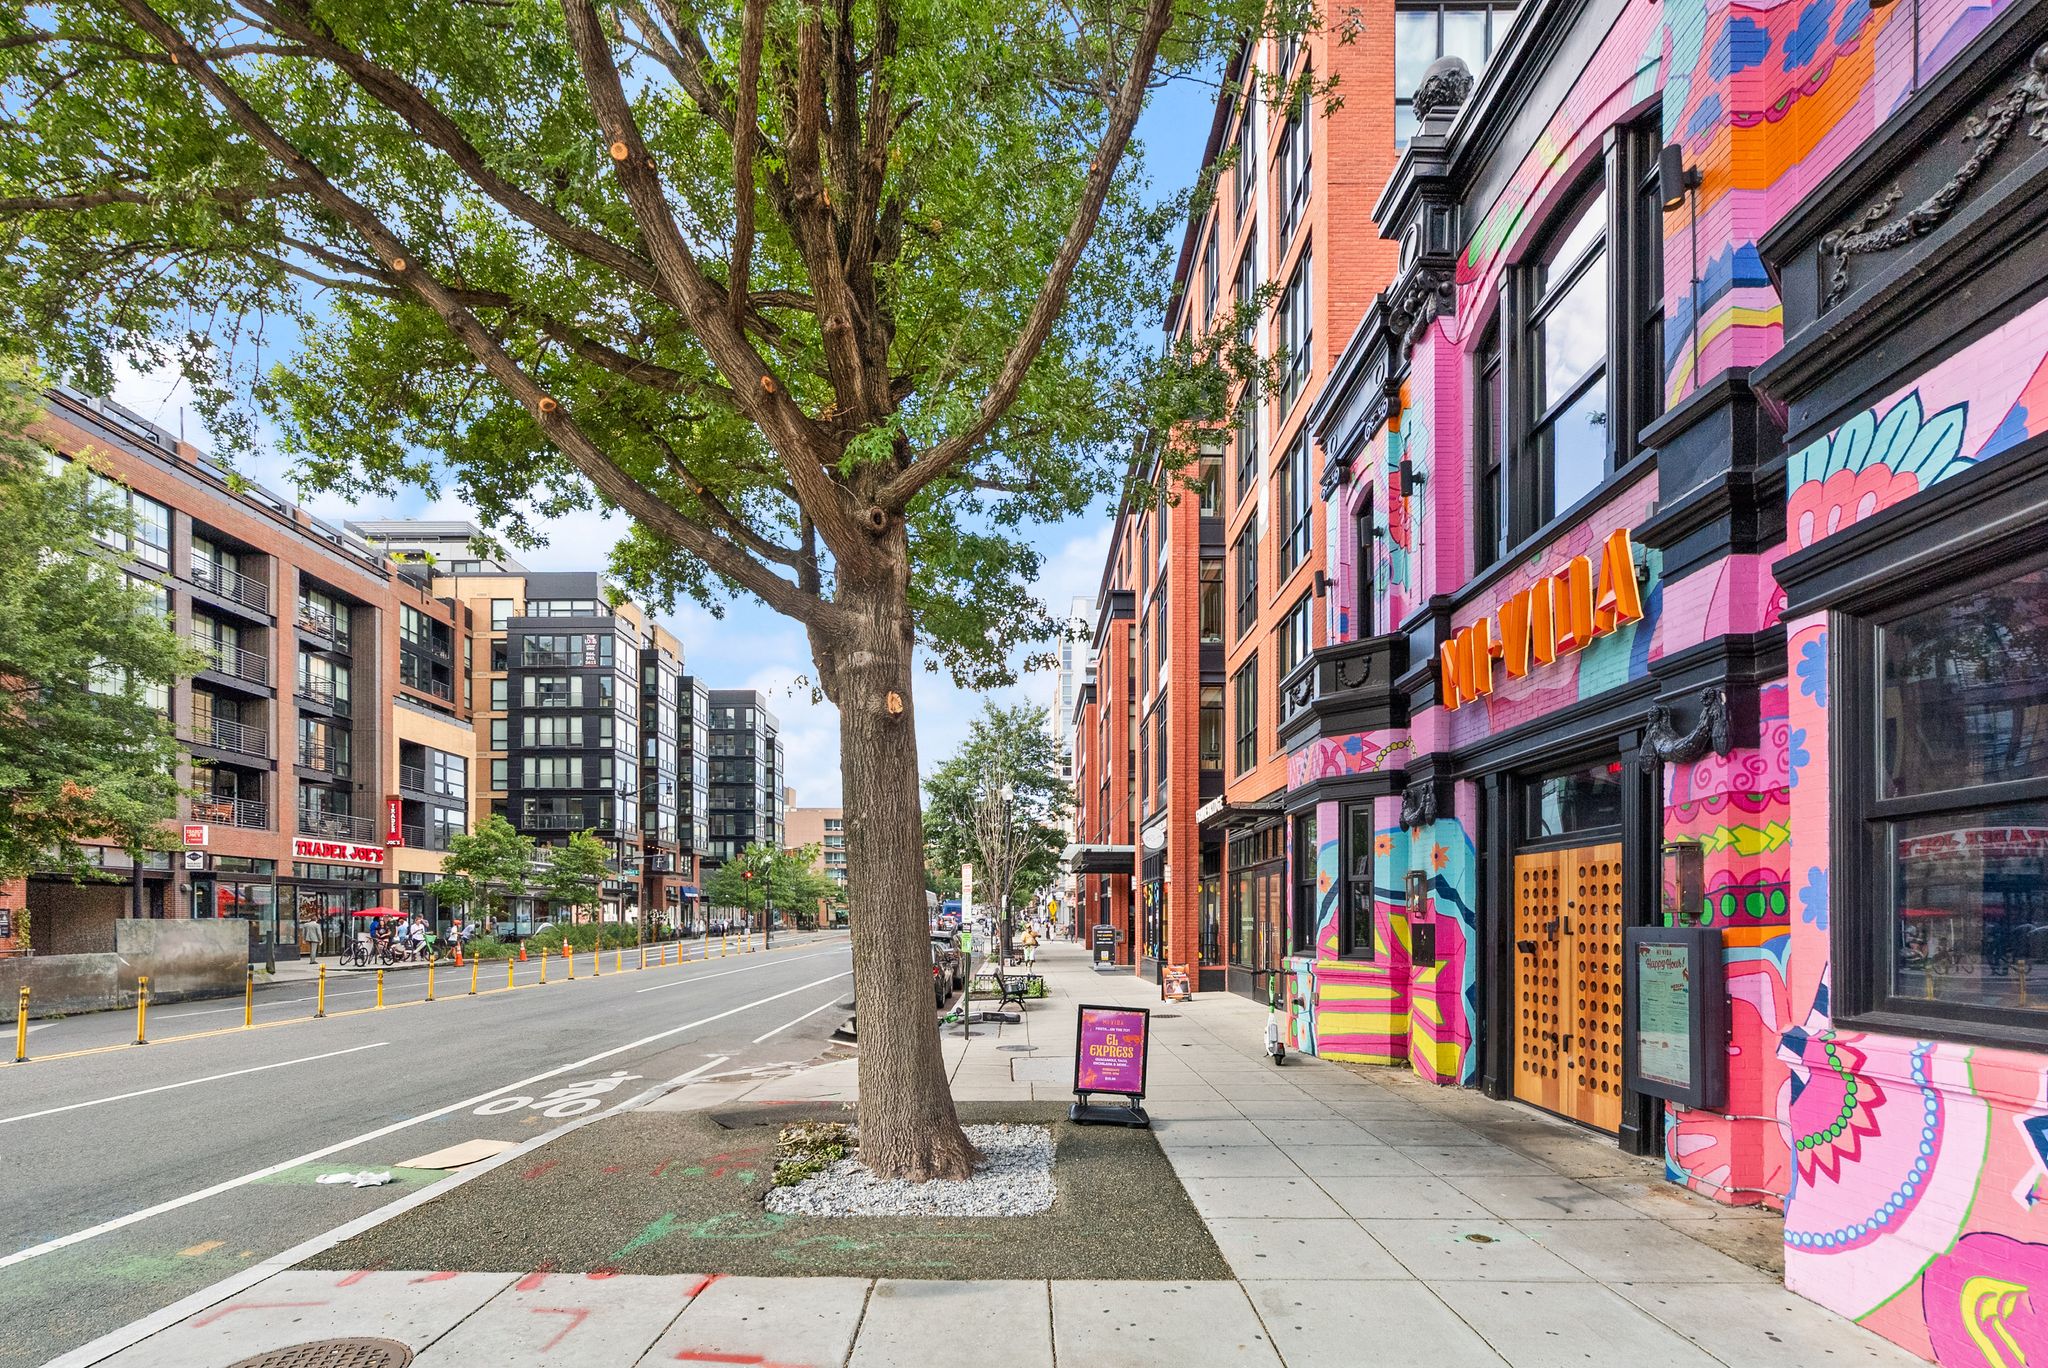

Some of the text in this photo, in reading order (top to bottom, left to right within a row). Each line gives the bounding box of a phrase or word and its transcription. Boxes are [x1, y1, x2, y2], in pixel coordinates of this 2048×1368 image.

[296, 840, 384, 863] TRADER JOE'S
[1106, 1034, 1118, 1046] EL
[1090, 1045, 1133, 1058] EXPRESS
